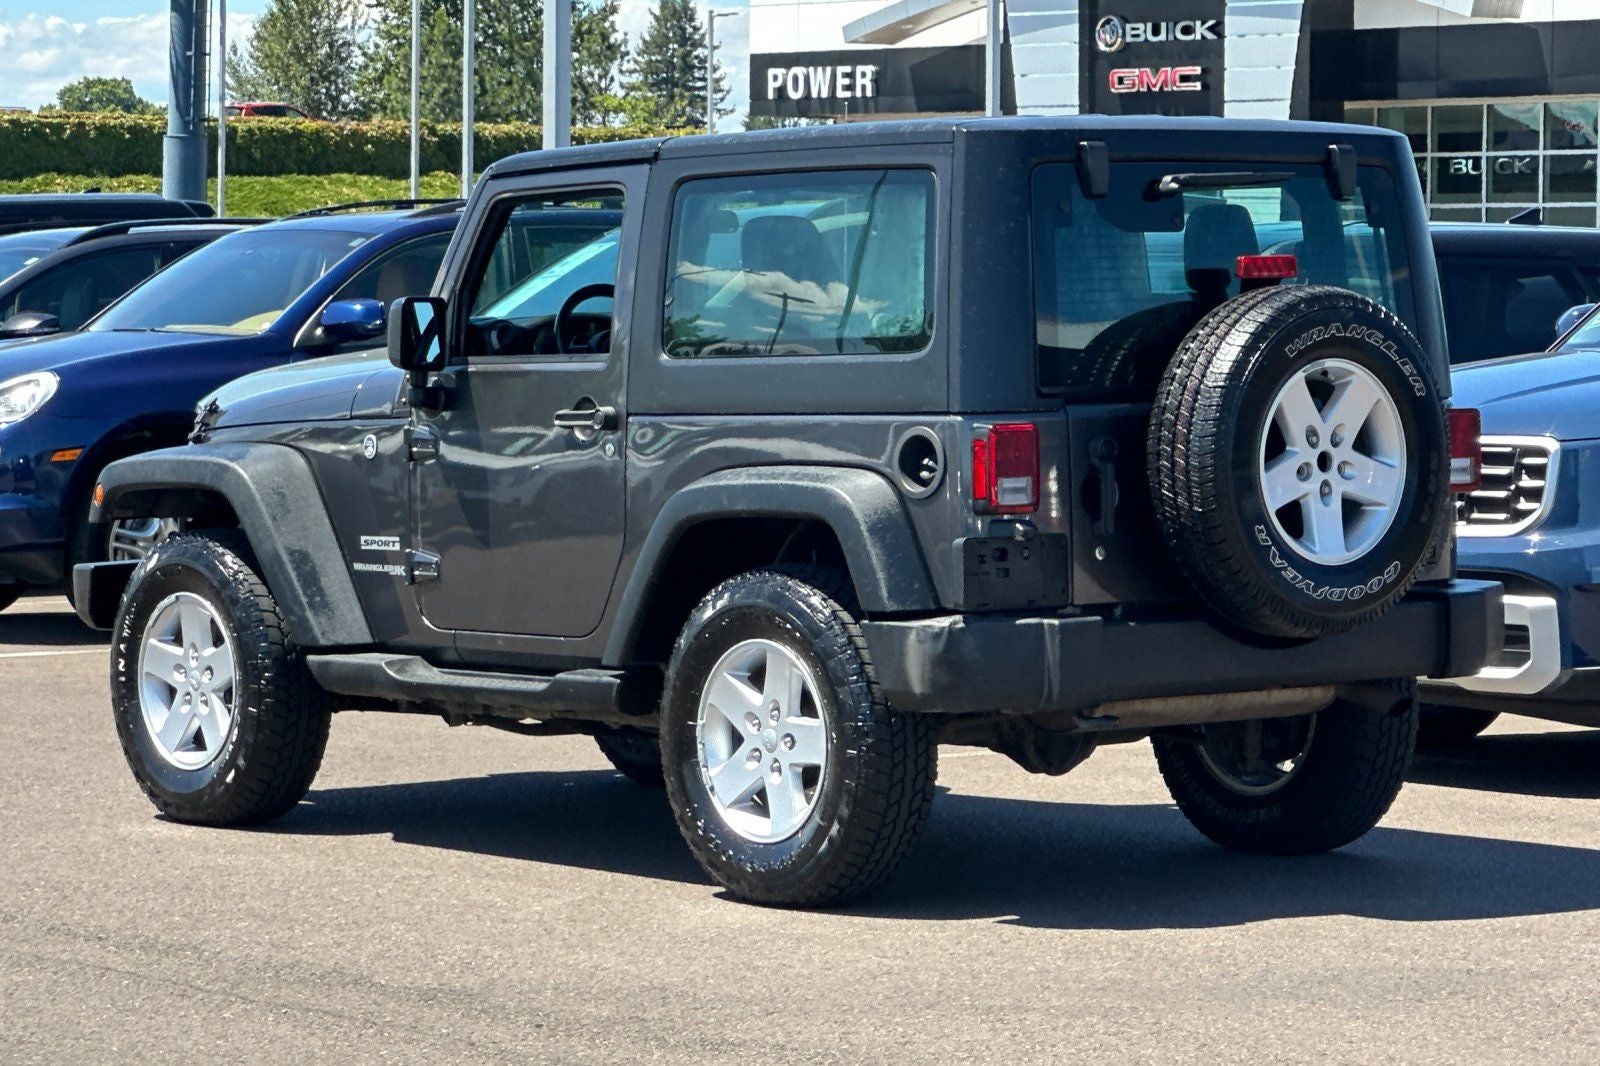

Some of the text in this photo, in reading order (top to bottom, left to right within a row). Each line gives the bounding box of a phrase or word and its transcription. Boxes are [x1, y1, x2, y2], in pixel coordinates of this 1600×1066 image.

[1125, 19, 1219, 42] BUICK
[766, 64, 877, 100] POWER
[1109, 66, 1202, 93] GMC
[1449, 157, 1533, 175] BUCK
[1285, 323, 1426, 397] WRANGLER
[361, 537, 400, 548] SPORT
[1254, 524, 1400, 601] GOODYEAR
